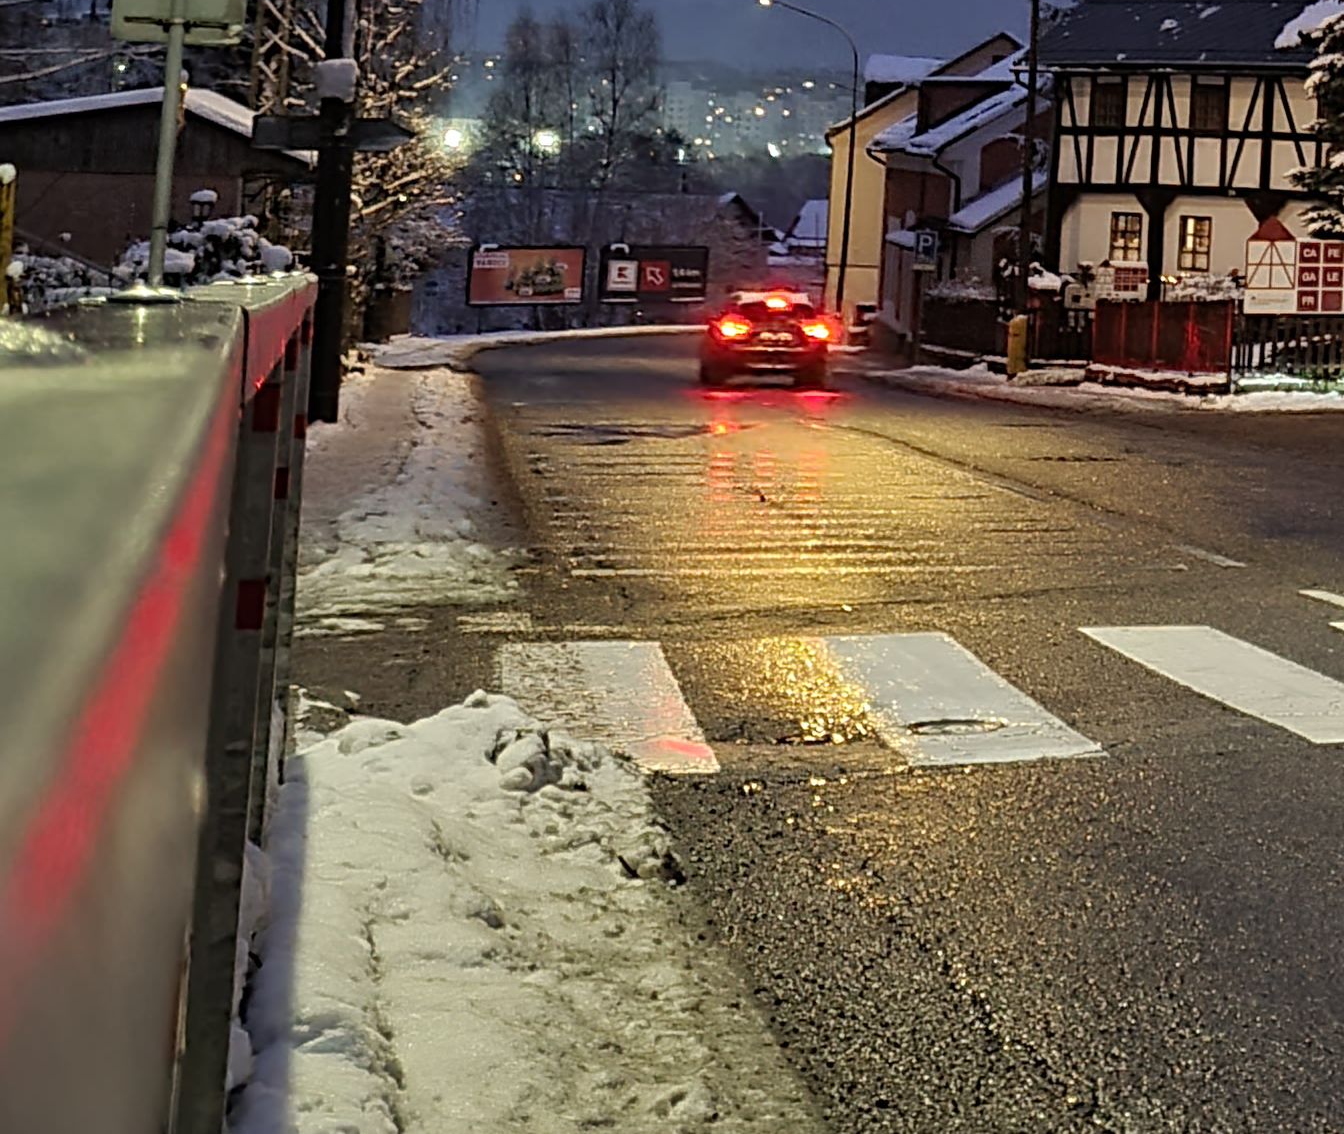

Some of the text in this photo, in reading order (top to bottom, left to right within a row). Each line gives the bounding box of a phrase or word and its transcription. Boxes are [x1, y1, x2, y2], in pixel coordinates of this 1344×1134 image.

[919, 235, 932, 253] P
[1303, 248, 1340, 258] CA FE
[1302, 272, 1316, 282] GA
[1326, 272, 1339, 282] LE
